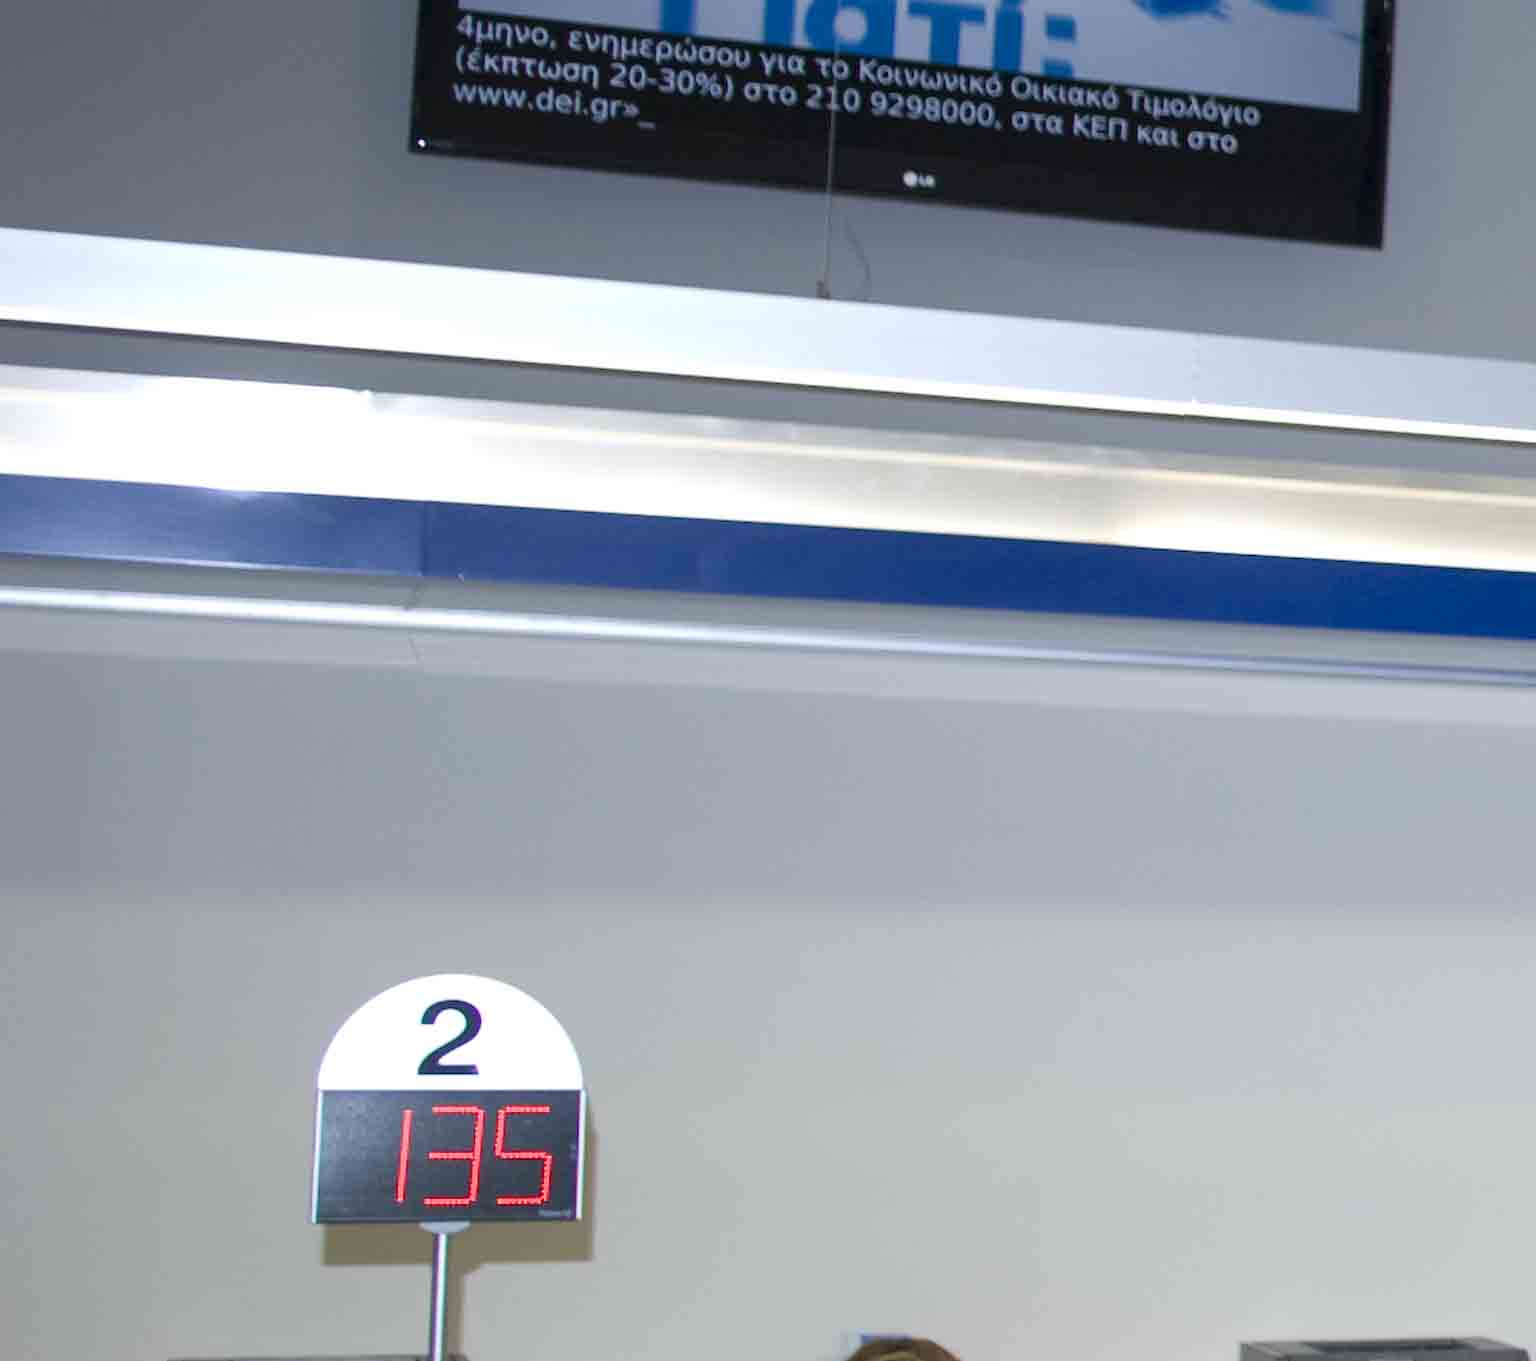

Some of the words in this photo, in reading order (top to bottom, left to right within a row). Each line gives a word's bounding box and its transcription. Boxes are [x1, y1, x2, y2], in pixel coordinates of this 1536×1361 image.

[455, 46, 600, 88] (έκπτωση
[609, 62, 734, 103] 20-30%)
[743, 85, 799, 107] στο
[804, 83, 861, 114] 210
[1011, 111, 1064, 136] στα
[1073, 115, 1128, 141] ΚΕΠ
[1136, 124, 1180, 149] και
[1187, 132, 1239, 154] στο
[567, 29, 751, 71] ενημερώσου
[759, 54, 805, 77] για
[815, 58, 849, 79] το
[859, 57, 1001, 98] Κοινωνικό
[1010, 76, 1120, 109] Οικιακό
[1127, 88, 1262, 129] Τιμολόγιο
[417, 999, 483, 1075] 2
[395, 1104, 553, 1206] 135
